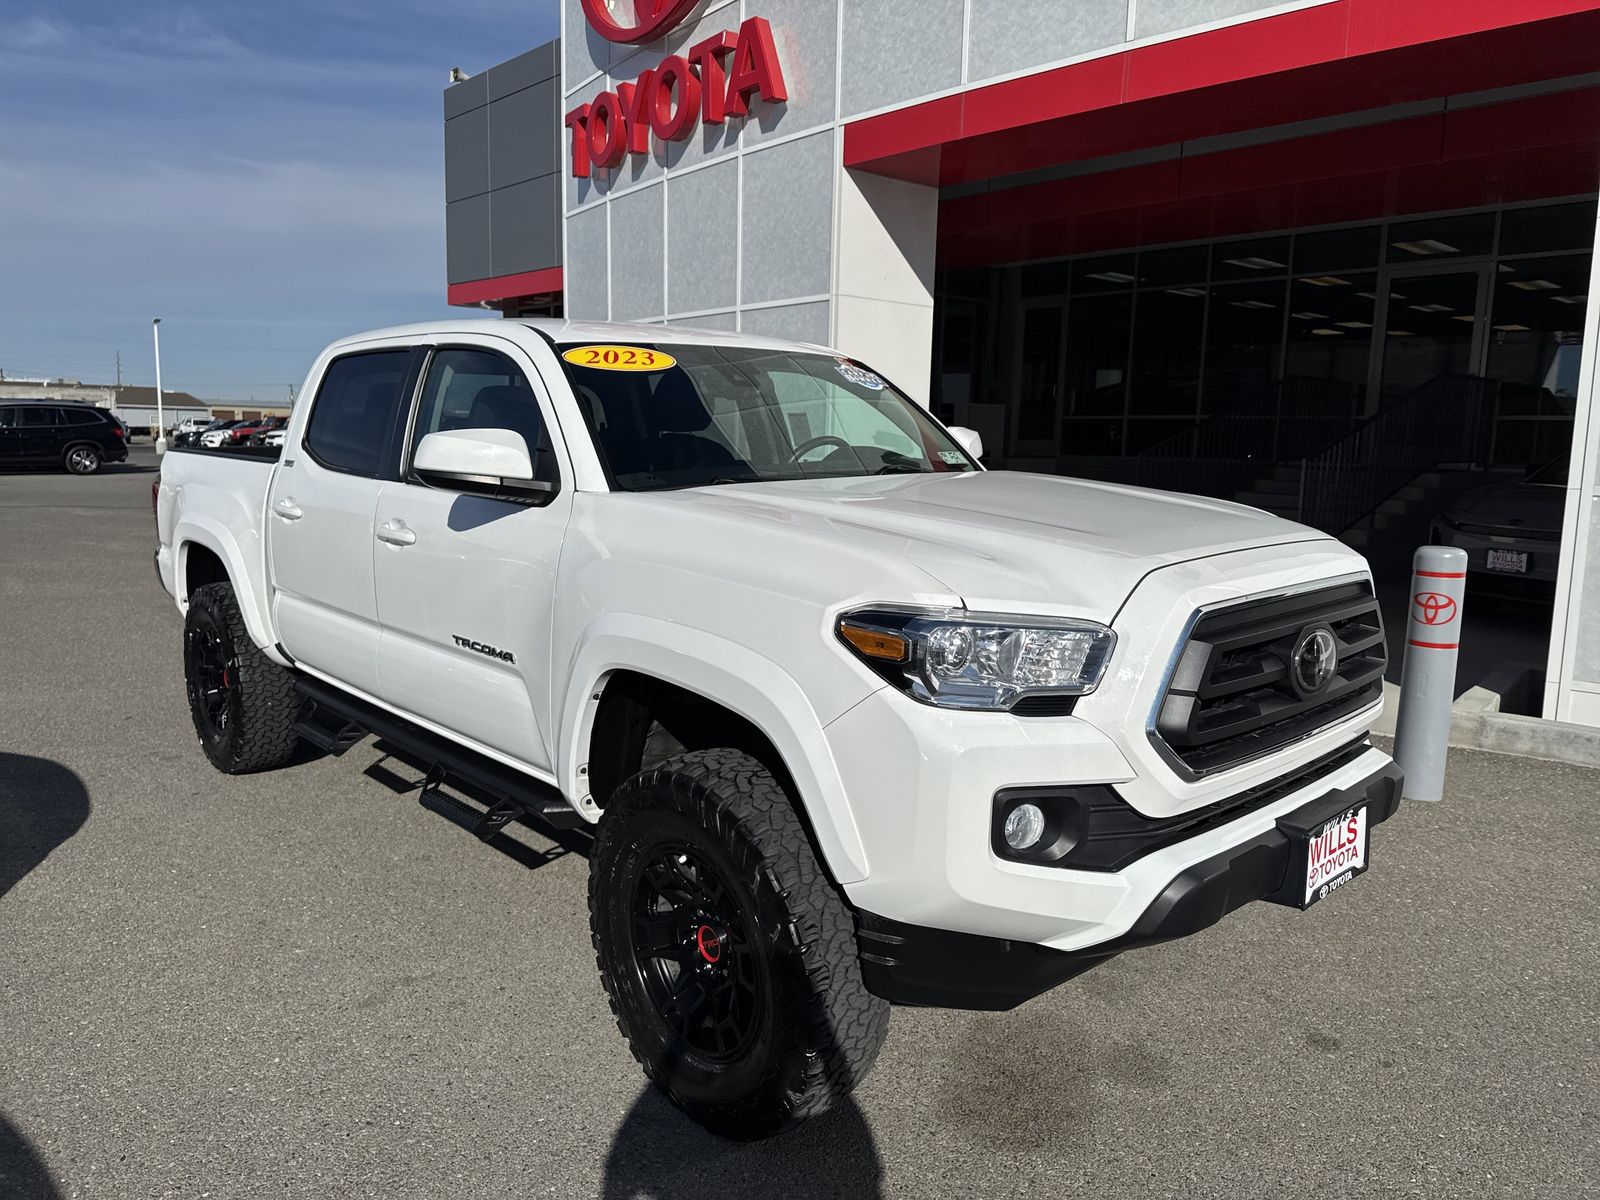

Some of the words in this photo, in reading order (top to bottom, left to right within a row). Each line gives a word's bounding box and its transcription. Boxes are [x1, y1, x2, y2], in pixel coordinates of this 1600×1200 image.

[565, 16, 788, 178] TOYOTA
[585, 350, 655, 366] 2023
[1492, 553, 1523, 564] WILLS
[452, 634, 516, 665] TACOMA
[1310, 818, 1358, 867] WILLS
[1319, 845, 1359, 879] TOYOTA
[1328, 870, 1353, 893] TOYOTA
